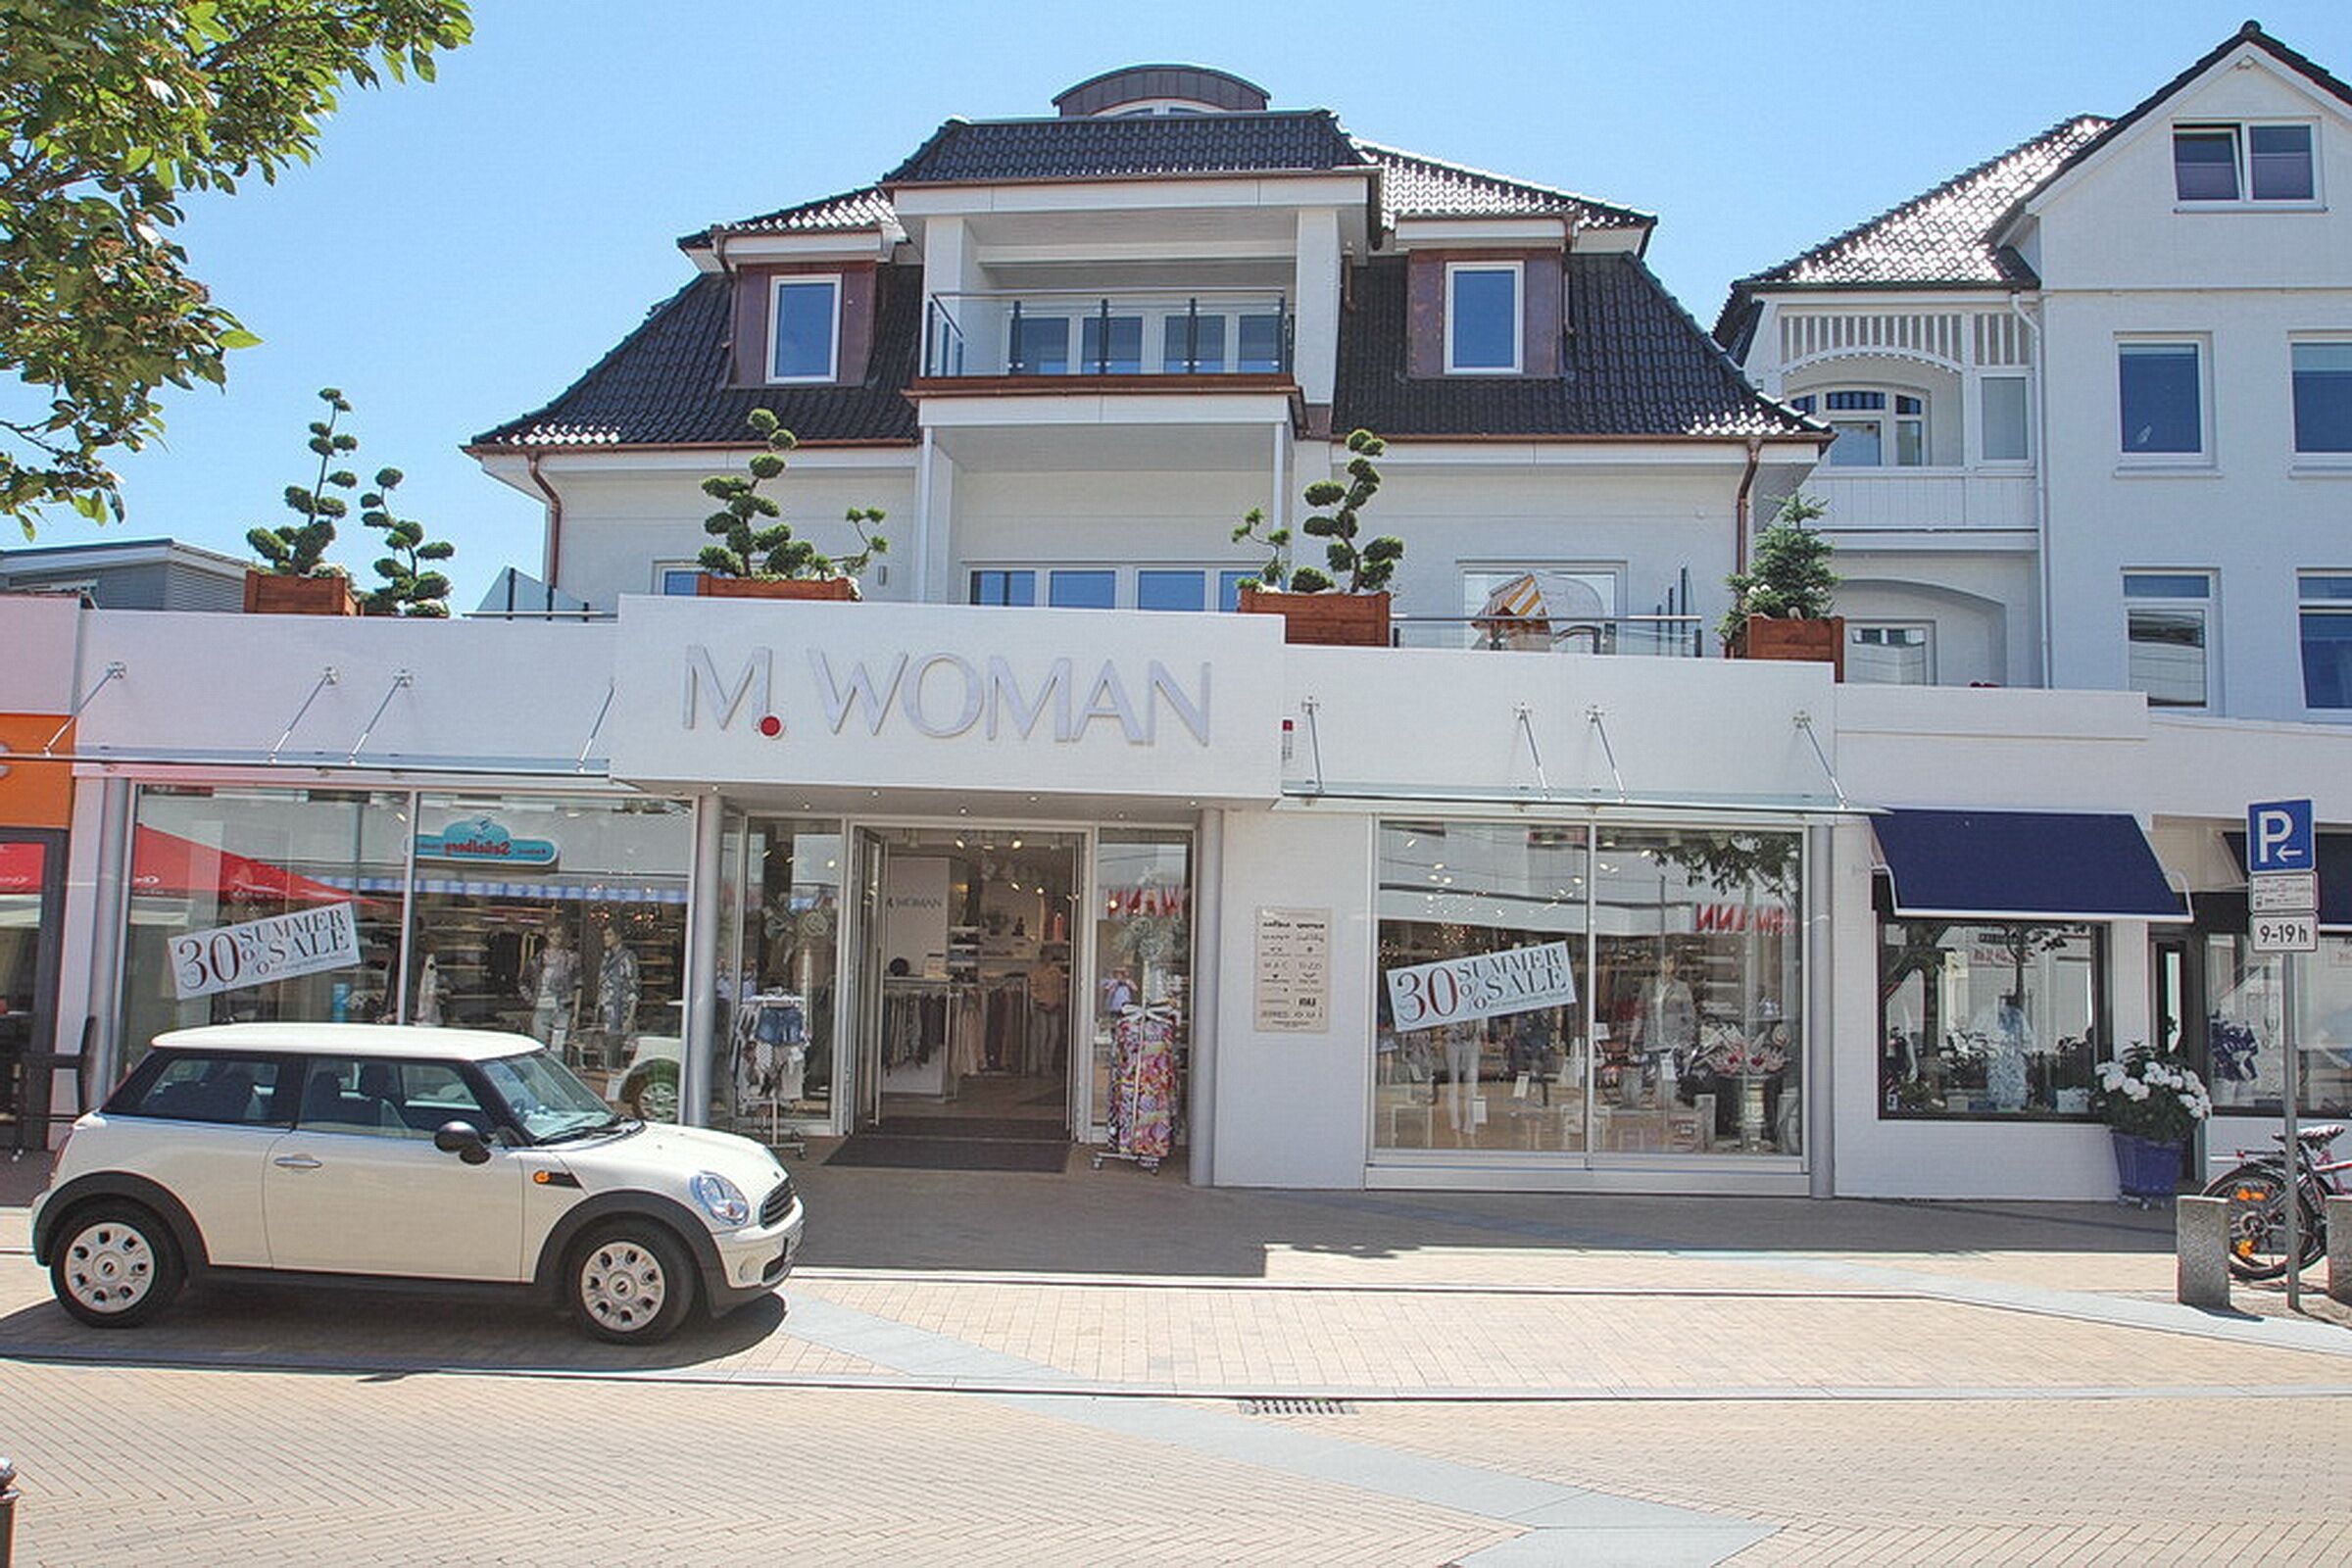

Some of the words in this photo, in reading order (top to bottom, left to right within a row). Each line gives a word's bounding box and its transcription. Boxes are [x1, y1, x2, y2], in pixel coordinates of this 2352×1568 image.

[806, 647, 1212, 747] WOMAN
[2257, 809, 2293, 863] P
[238, 907, 346, 946] SUMMER
[269, 929, 351, 965] SALE
[1456, 947, 1561, 981] SUMMER
[1476, 967, 1568, 1001] SALE
